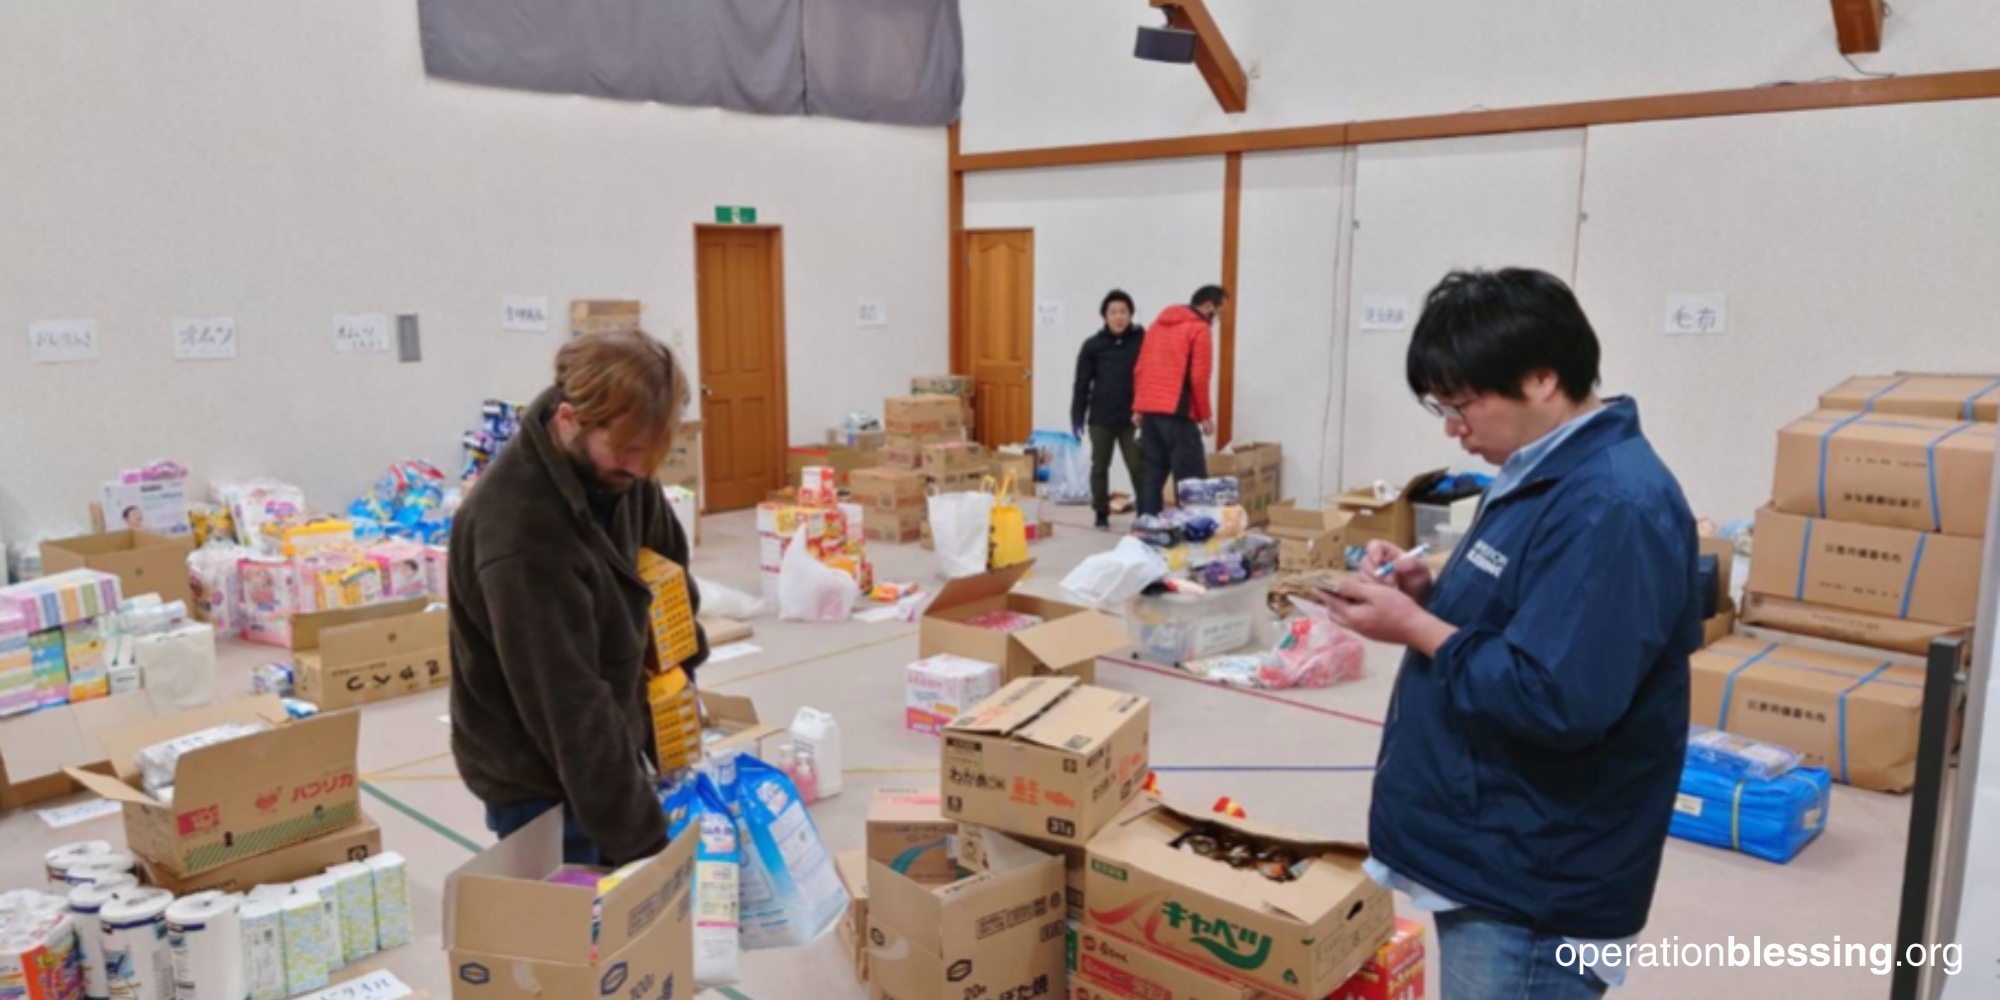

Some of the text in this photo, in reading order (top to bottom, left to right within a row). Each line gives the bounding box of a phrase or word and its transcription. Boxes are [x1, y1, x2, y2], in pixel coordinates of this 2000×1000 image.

[1671, 304, 1717, 332] 毛布
[178, 324, 233, 346] オムツ
[291, 773, 354, 802] パプリカ
[1161, 900, 1272, 970] キャベツ
